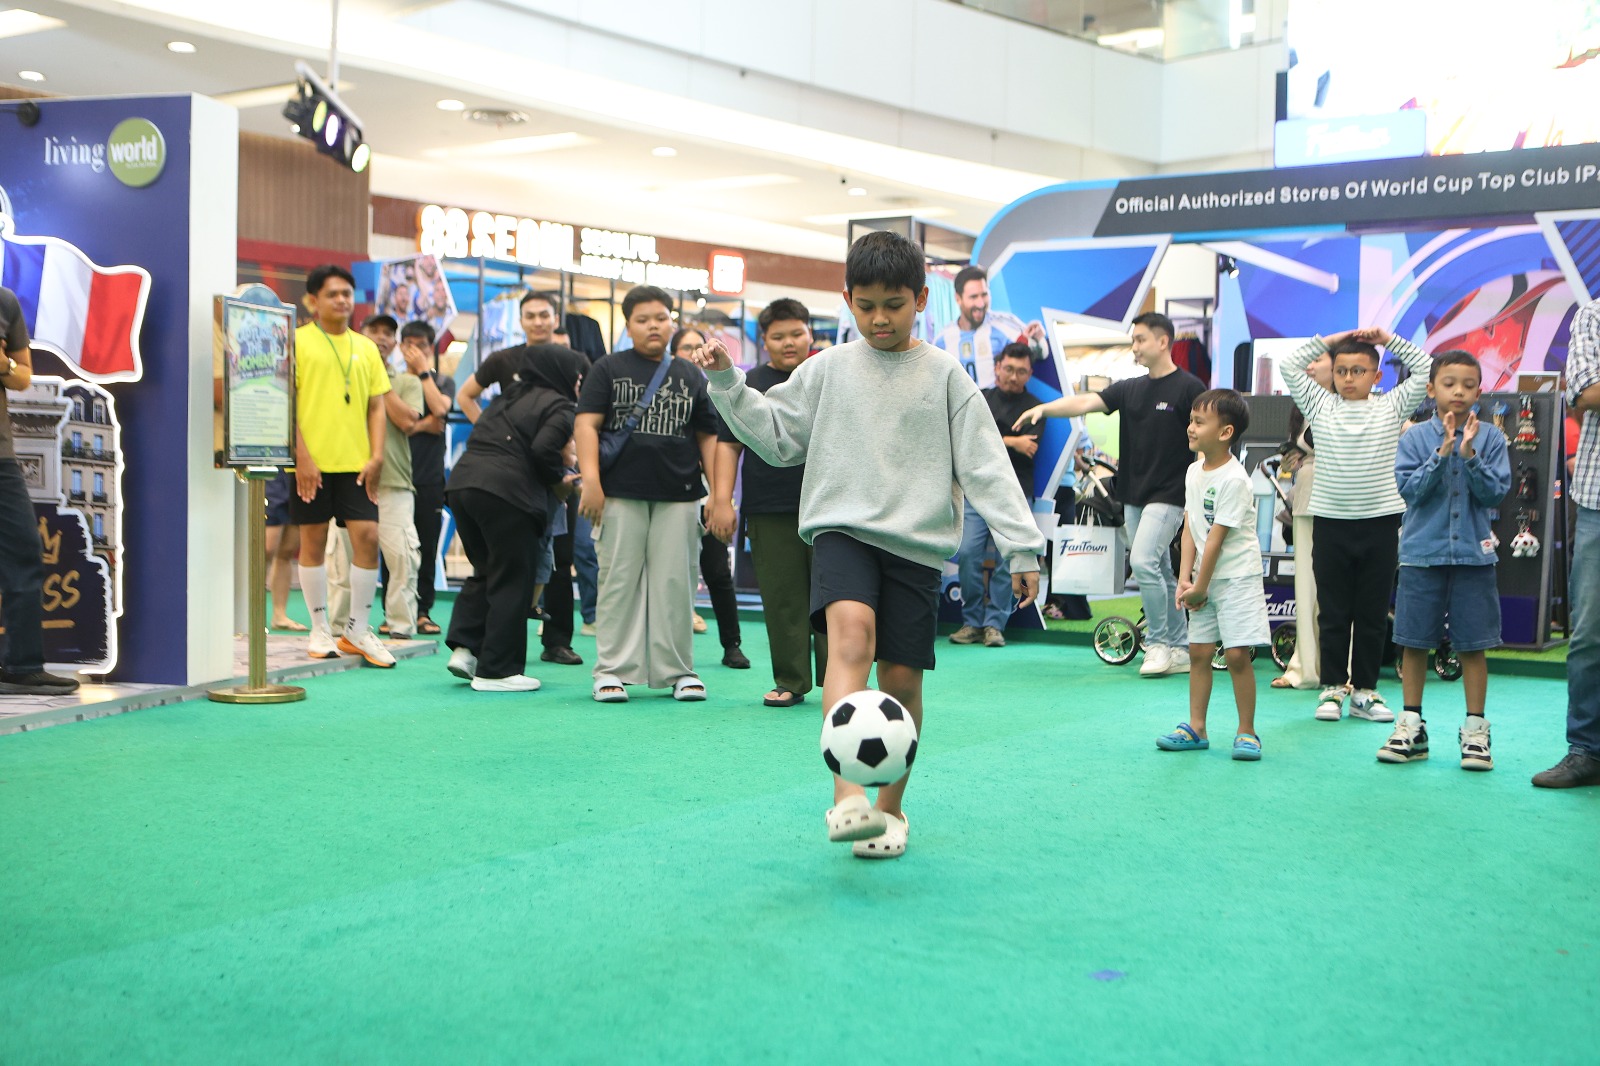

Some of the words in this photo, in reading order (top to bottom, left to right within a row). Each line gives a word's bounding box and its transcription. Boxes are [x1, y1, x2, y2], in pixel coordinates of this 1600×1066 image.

[44, 135, 105, 173] living
[110, 134, 158, 163] world
[1115, 194, 1174, 215] Official
[1178, 187, 1276, 211] Authorized
[1280, 185, 1340, 204] Stores
[1345, 180, 1368, 200] Of
[1371, 177, 1429, 198] World
[1433, 174, 1474, 195] Cup
[1478, 172, 1516, 193] Top
[1521, 167, 1570, 187] Club
[1060, 538, 1108, 556] FanTown
